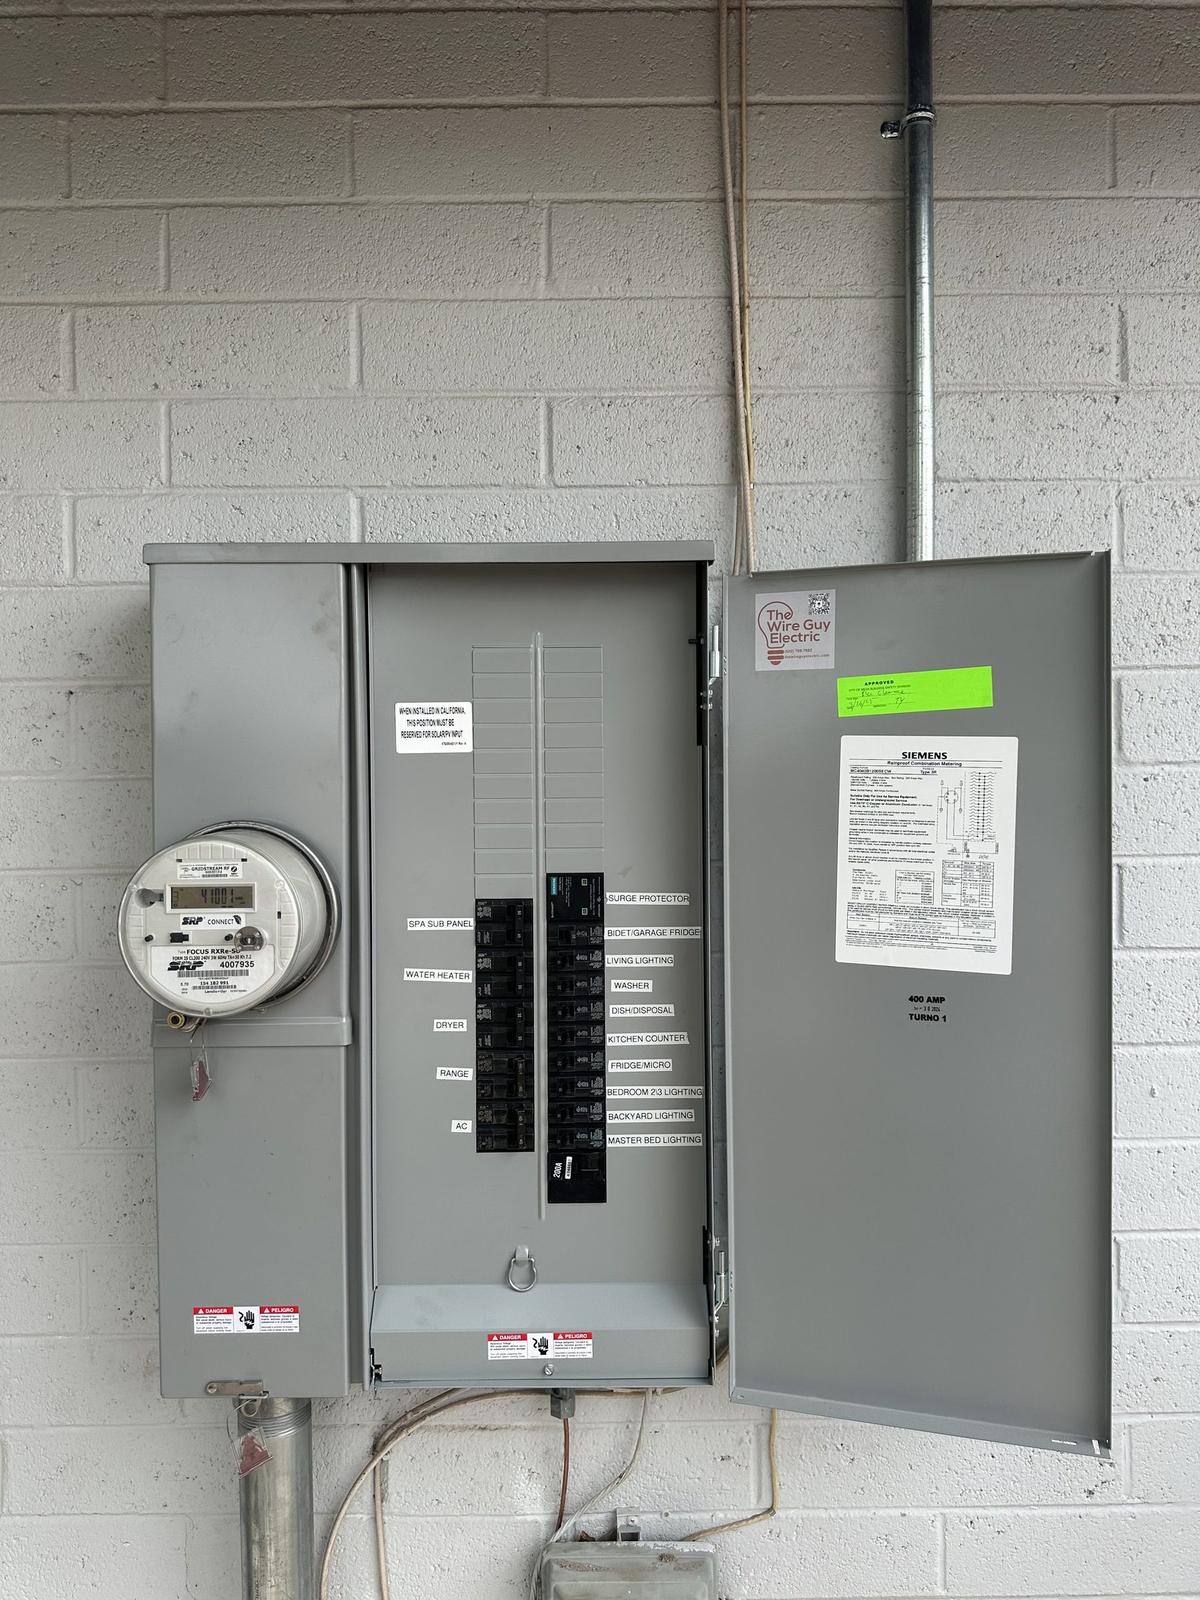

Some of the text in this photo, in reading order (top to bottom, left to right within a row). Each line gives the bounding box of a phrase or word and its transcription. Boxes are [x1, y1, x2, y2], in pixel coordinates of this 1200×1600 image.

[767, 610, 792, 620] The
[767, 619, 830, 632] Wire Guy
[770, 631, 820, 644] Electric
[182, 917, 203, 925] SRP
[168, 961, 204, 971] SRP
[553, 1162, 562, 1178] 200A
